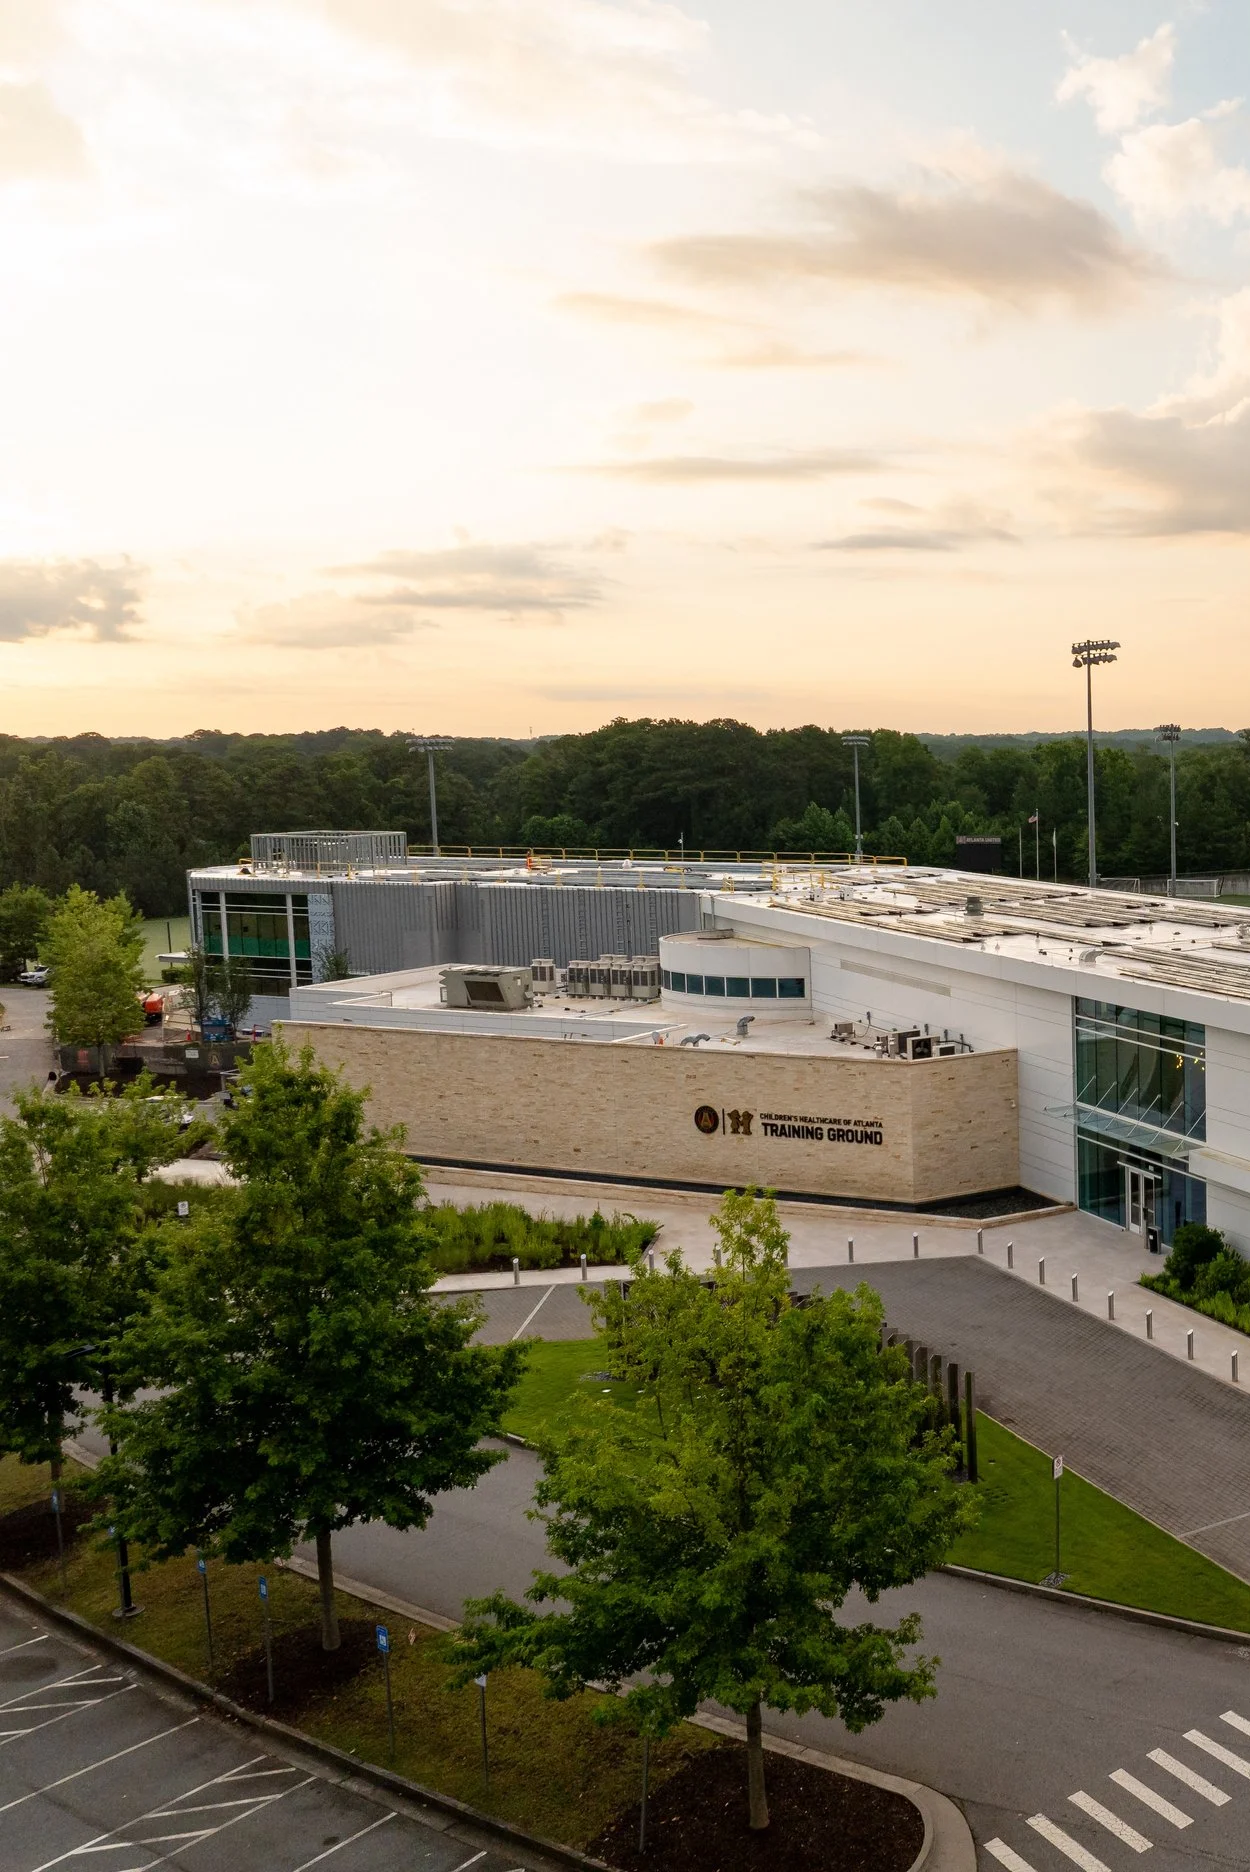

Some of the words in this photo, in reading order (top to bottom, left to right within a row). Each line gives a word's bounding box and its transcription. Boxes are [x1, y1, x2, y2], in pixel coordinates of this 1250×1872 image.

[759, 1112, 799, 1122] CHILDREN'S
[799, 1116, 842, 1126] HEALTHCARE
[853, 1120, 884, 1129] ATLANTA
[761, 1122, 824, 1141] TRAINING
[827, 1126, 883, 1146] GROUND
